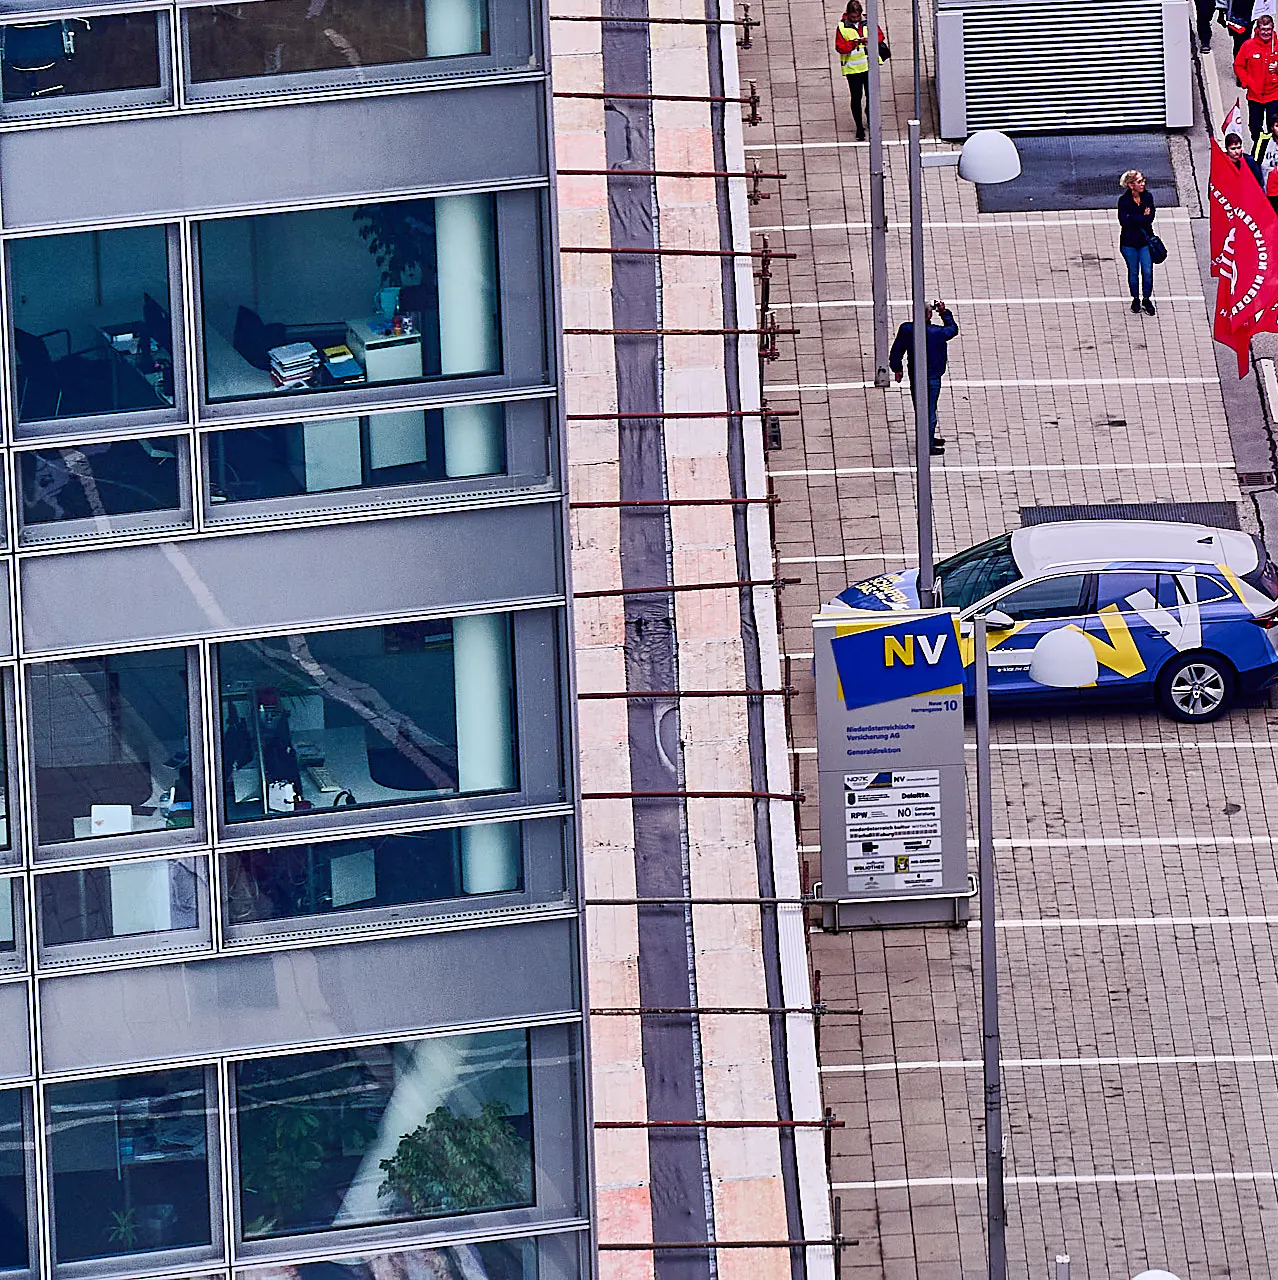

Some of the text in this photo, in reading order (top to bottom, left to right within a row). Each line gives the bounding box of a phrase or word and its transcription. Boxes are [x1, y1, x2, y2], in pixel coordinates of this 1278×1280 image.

[884, 634, 948, 667] NV
[943, 700, 958, 711] 10
[847, 724, 915, 733] Niederösterreichische
[847, 733, 888, 741] Versicherung
[847, 747, 901, 756] Generaldirektion
[902, 792, 930, 800] Deloitte.
[898, 807, 911, 818] NÖ
